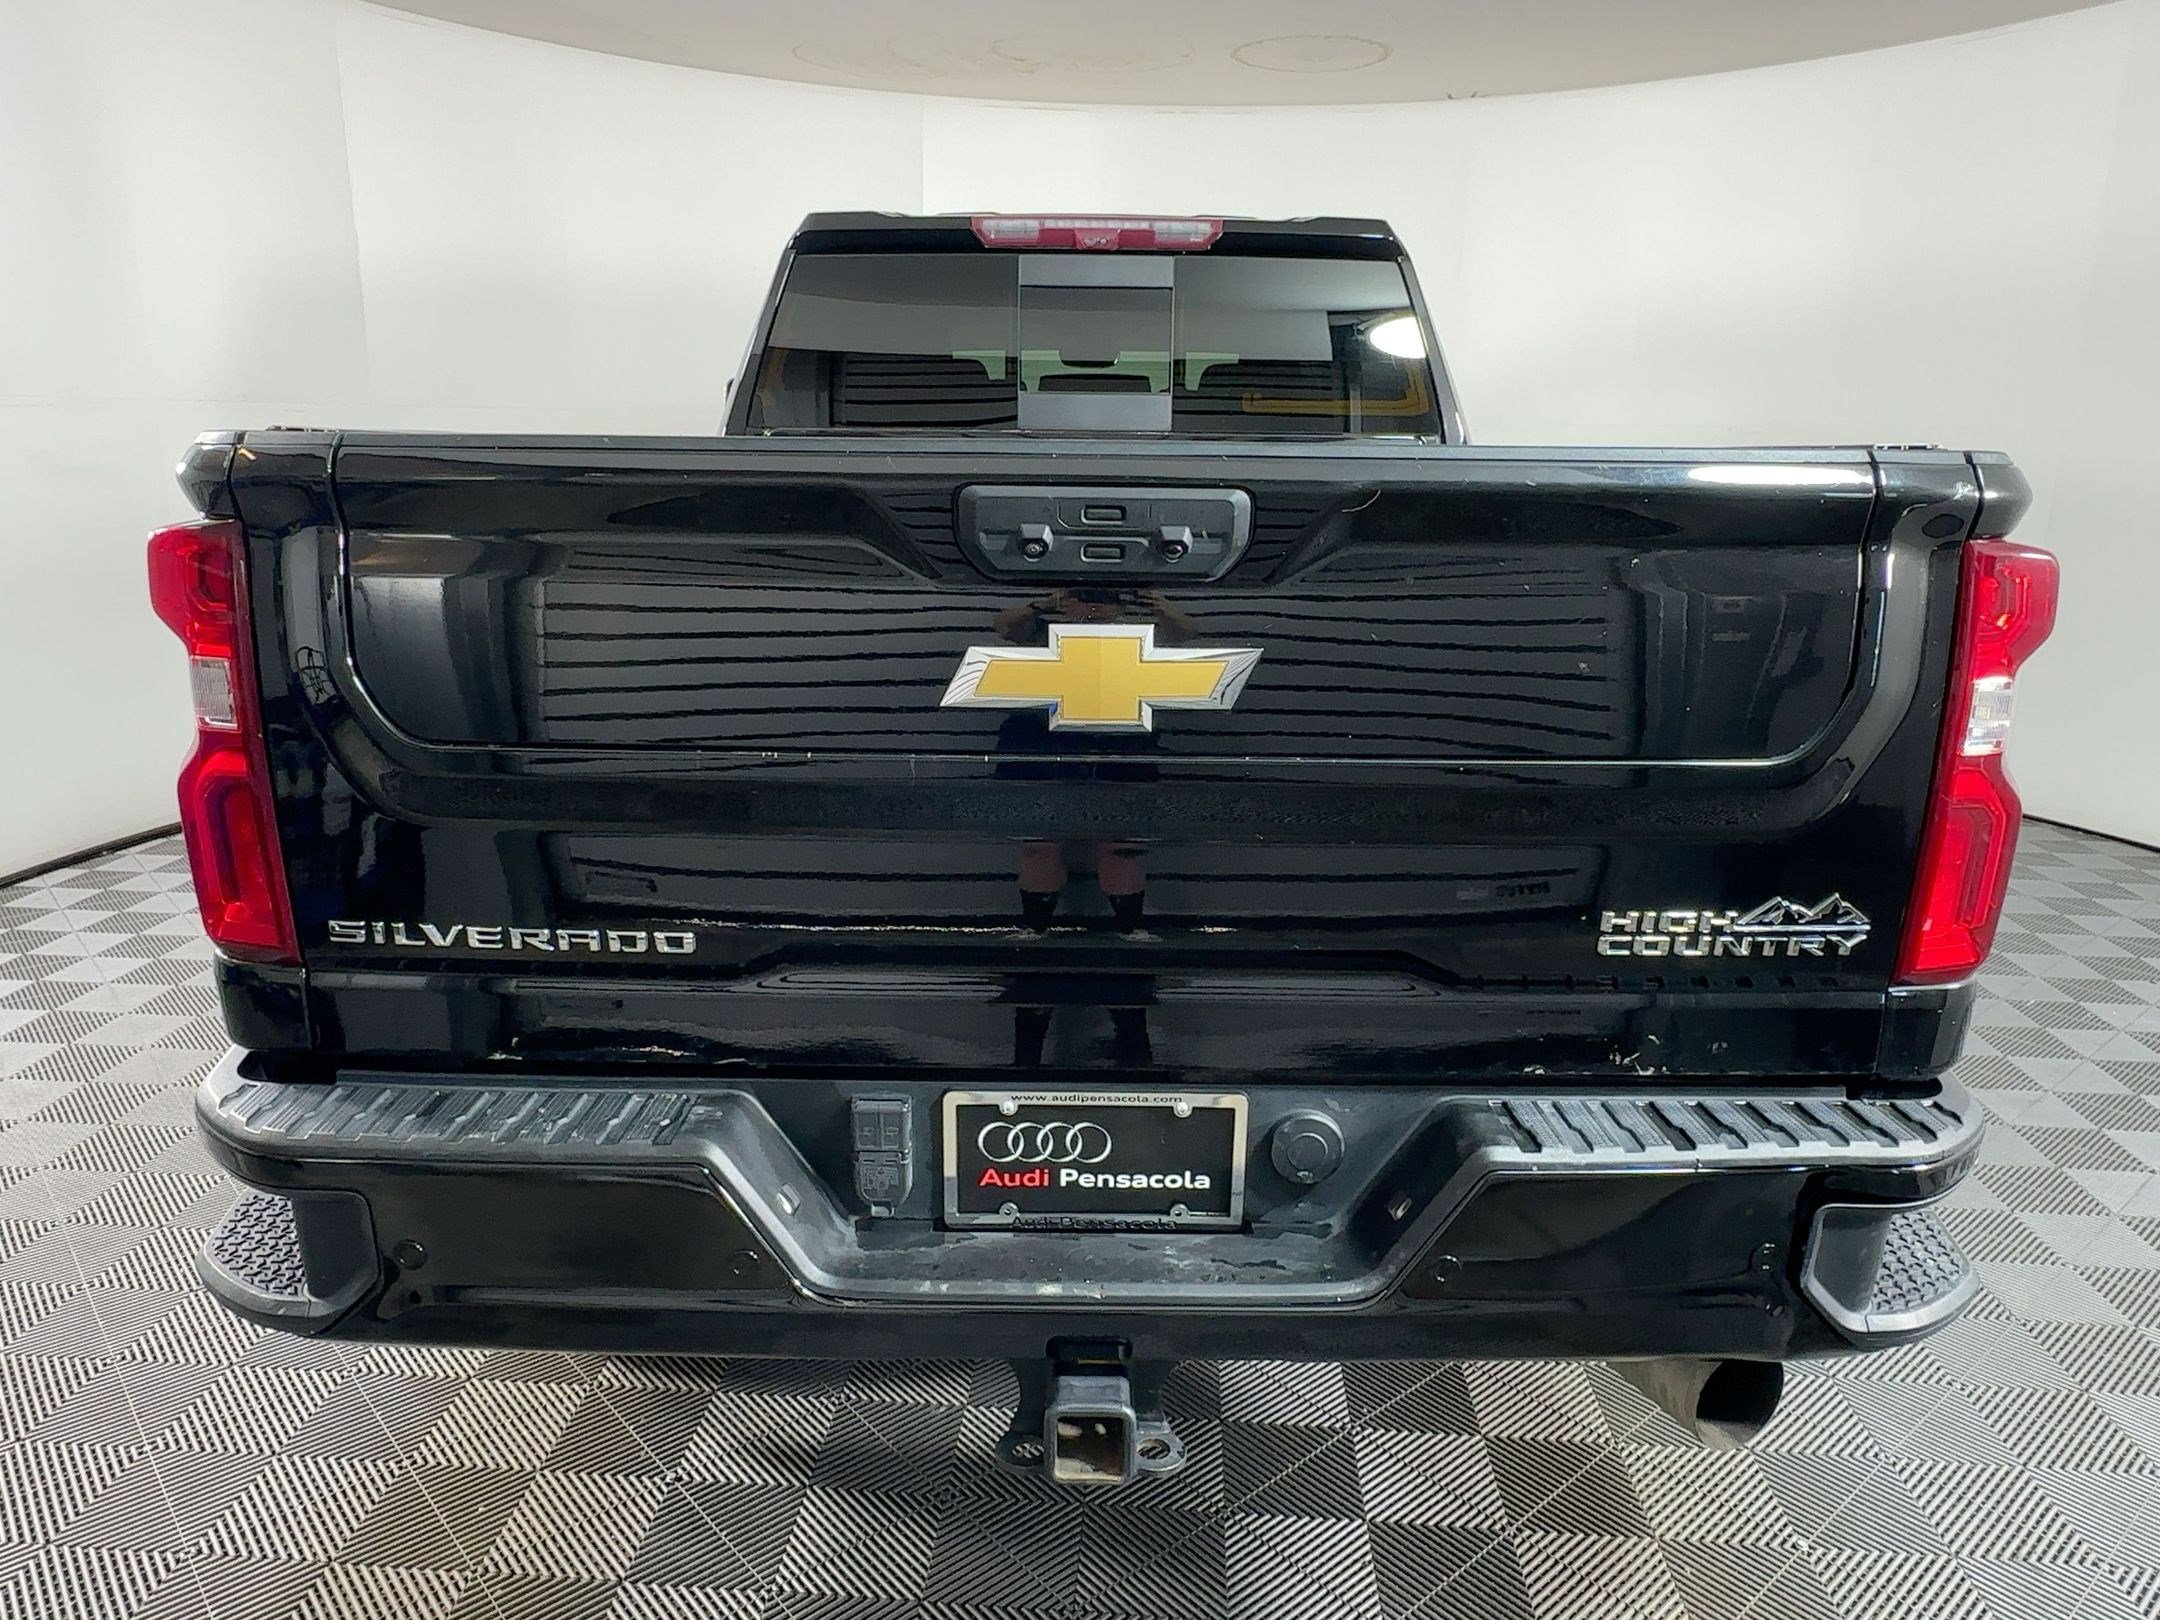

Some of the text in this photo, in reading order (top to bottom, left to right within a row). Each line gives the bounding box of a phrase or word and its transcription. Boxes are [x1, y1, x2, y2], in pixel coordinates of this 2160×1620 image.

[1600, 910, 1739, 934] HIGH
[327, 919, 698, 955] SILVERADO
[1597, 933, 1868, 957] COUNTRY
[1011, 1093, 1183, 1104] www.audipensacola.com
[979, 1168, 1211, 1190] Audi Pensacola
